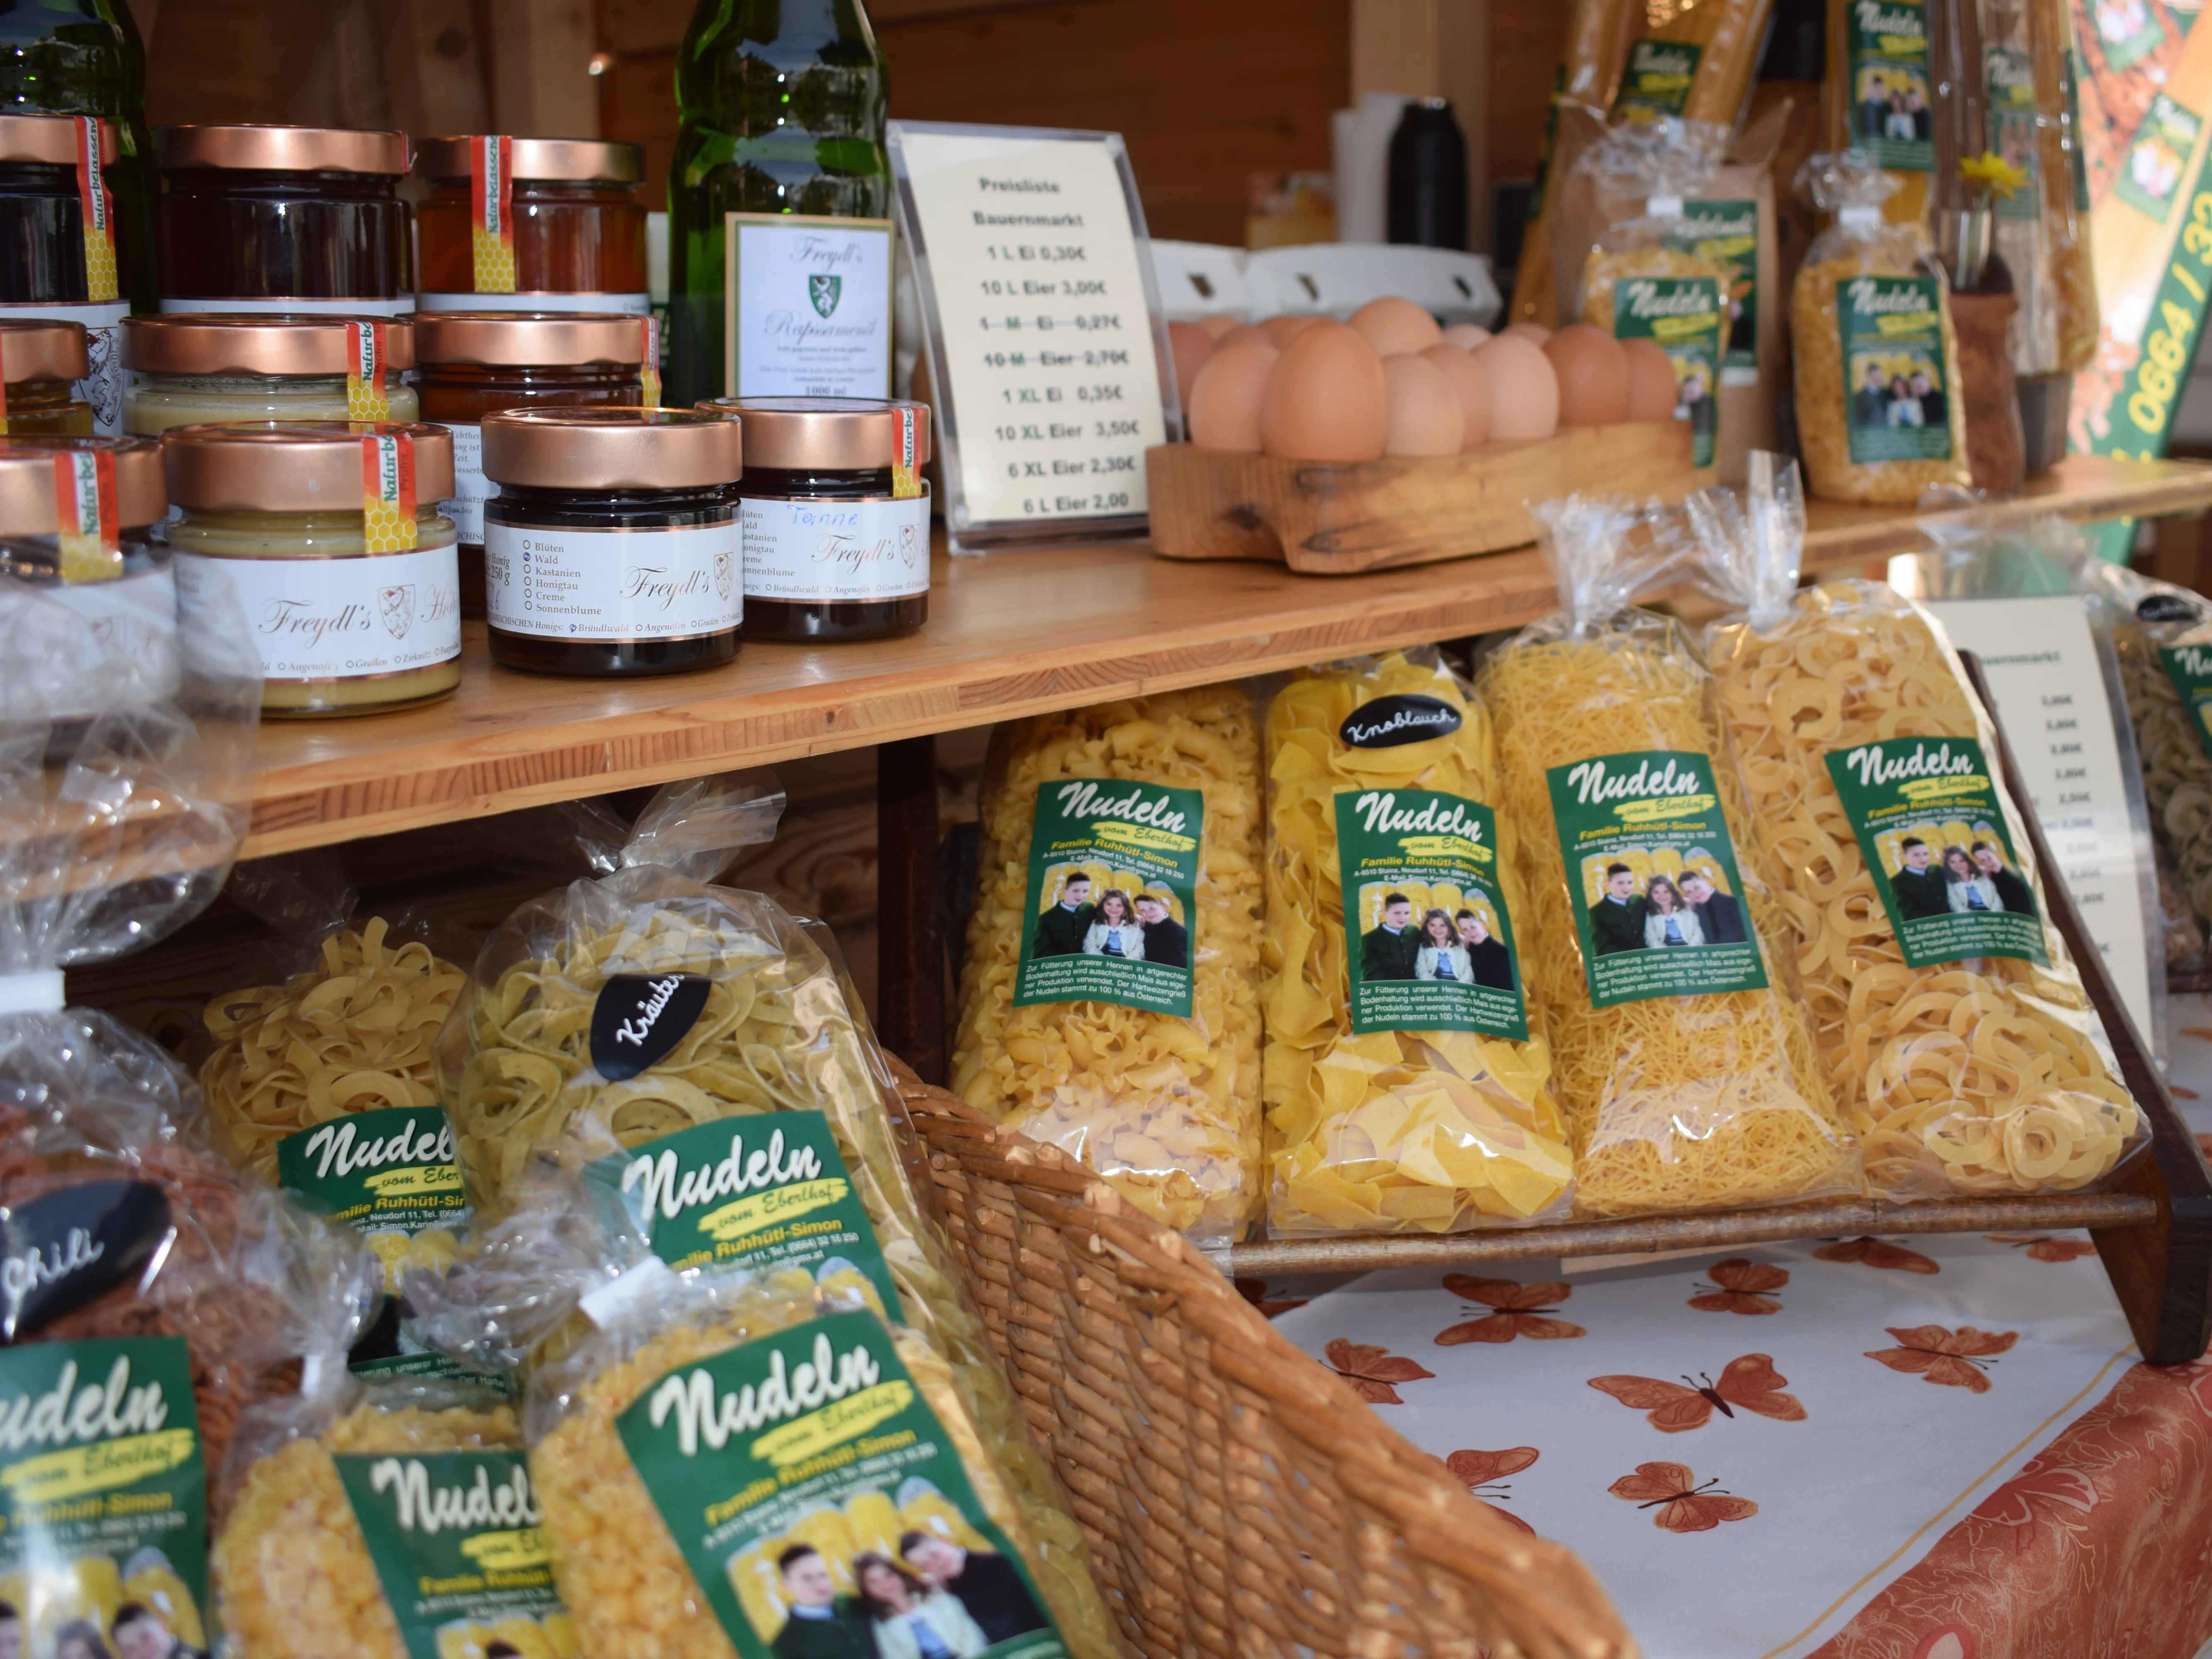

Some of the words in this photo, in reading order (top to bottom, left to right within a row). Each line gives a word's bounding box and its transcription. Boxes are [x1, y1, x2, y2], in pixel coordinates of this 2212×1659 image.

[979, 178, 1060, 194] Preisliste
[973, 211, 1084, 227] Bauernmarkt
[988, 246, 996, 260] 1
[1003, 246, 1014, 260] L
[1019, 246, 1035, 260] Ei
[1040, 246, 1087, 262] 0,30€
[981, 280, 1002, 295] 10
[1007, 281, 1018, 295] L
[1023, 280, 1055, 294] Eier
[1062, 280, 1107, 296] 3,00€
[980, 317, 989, 330] 1
[1006, 316, 1021, 329] M
[1037, 316, 1053, 329] Ei
[984, 353, 1005, 367] 10
[1011, 353, 1025, 366] M
[1041, 352, 1073, 366] Eier
[1085, 350, 1129, 367] 2,70€
[2128, 299, 2195, 435] 0664
[1003, 389, 1011, 403] 1
[1018, 388, 1041, 403] XL
[1046, 388, 1062, 402] Ei
[1078, 386, 1123, 403] 0,35€
[995, 426, 1015, 440] 10
[1021, 426, 1043, 440] XL
[1049, 424, 1082, 438] Eier
[1096, 421, 1140, 438] 3,50€
[1009, 464, 1018, 477] 6
[1024, 462, 1046, 477] XL
[1052, 460, 1084, 475] Eier
[1091, 457, 1136, 474] 2,30€
[1024, 500, 1034, 513] 6
[1040, 499, 1050, 512] L
[1056, 497, 1087, 511] Eier
[1093, 493, 1129, 509] 2,00
[535, 542, 564, 552] Blüten
[811, 533, 895, 575] Freydl's
[492, 553, 510, 570] Honig
[535, 555, 558, 564] Wald
[492, 565, 502, 580] 250
[504, 573, 510, 586] g
[535, 567, 581, 577] Kastanien
[536, 579, 578, 591] Honigtau
[619, 566, 709, 611] Freydl's
[774, 584, 819, 593] Bründlwald
[833, 586, 871, 594] Angenofen
[536, 591, 565, 601] Creme
[537, 604, 602, 615] Sonnenblume
[258, 598, 372, 649] Freydl's
[535, 621, 564, 632] Honigs:
[578, 623, 629, 632] Bründlwald
[645, 621, 686, 633] Angenofen
[698, 617, 719, 627] Graden
[355, 658, 388, 669] Graden
[403, 651, 431, 664] Zirknitz
[1347, 708, 1457, 742] Knoblauch
[1847, 742, 1974, 786] Nudeln
[1567, 758, 1700, 804] Nudeln
[1057, 781, 1186, 833] Nudeln
[1355, 791, 1483, 842] Nudeln
[1626, 806, 1650, 816] vom
[1656, 798, 1706, 812] Eberlhof
[1868, 804, 1908, 818] Familie
[1104, 826, 1128, 836] vom
[1134, 827, 1186, 850] Eberlhof
[1579, 825, 1621, 841] Familie
[1623, 821, 1706, 833] Ruhhütl-Simon
[1051, 838, 1092, 850] Familie
[1095, 838, 1178, 868] Ruhhütl-Simon
[1411, 842, 1435, 850] vom
[1442, 836, 1484, 861] Eberlhof
[1043, 850, 1065, 859] A-8510
[1088, 847, 1114, 858] Neudorf
[1125, 856, 1135, 865] Tel.
[1137, 859, 1155, 871] (0664)
[1173, 869, 1185, 879] 250
[1070, 853, 1093, 862] E-Mail:
[1093, 855, 1156, 879] Simon.Karin@gmx.at
[1361, 857, 1403, 867] Familie
[1406, 856, 1484, 877] Ruhhütl-Simon
[1026, 969, 1071, 980] Bodenhaltung
[1089, 968, 1136, 980] ausschließlich
[1138, 974, 1154, 984] Mais
[1169, 981, 1186, 989] eige-
[1041, 960, 1073, 970] Fütterung
[1107, 961, 1133, 971] Hennen
[1146, 968, 1187, 980] artgerechter
[1037, 976, 1074, 987] Produktion
[1077, 977, 1114, 985] verwendet.
[1117, 979, 1129, 988] Der
[1132, 982, 1186, 997] Hartweizengrieß
[1037, 986, 1060, 995] Nudeln
[1061, 984, 1087, 992] stammt
[1099, 985, 1112, 994] 100
[1136, 991, 1174, 1005] Österreich.
[615, 971, 685, 1047] Kräuter
[382, 1177, 416, 1187] vom
[621, 1128, 822, 1221] Nudeln
[371, 1211, 406, 1221] Neudorf
[440, 1209, 465, 1219] (0664)
[719, 1209, 753, 1228] vom
[762, 1184, 833, 1214] Eberlhof
[715, 1219, 842, 1258] Ruhhütl-Simon
[649, 1331, 880, 1457] Nudeln
[704, 1477, 778, 1526] Familie
